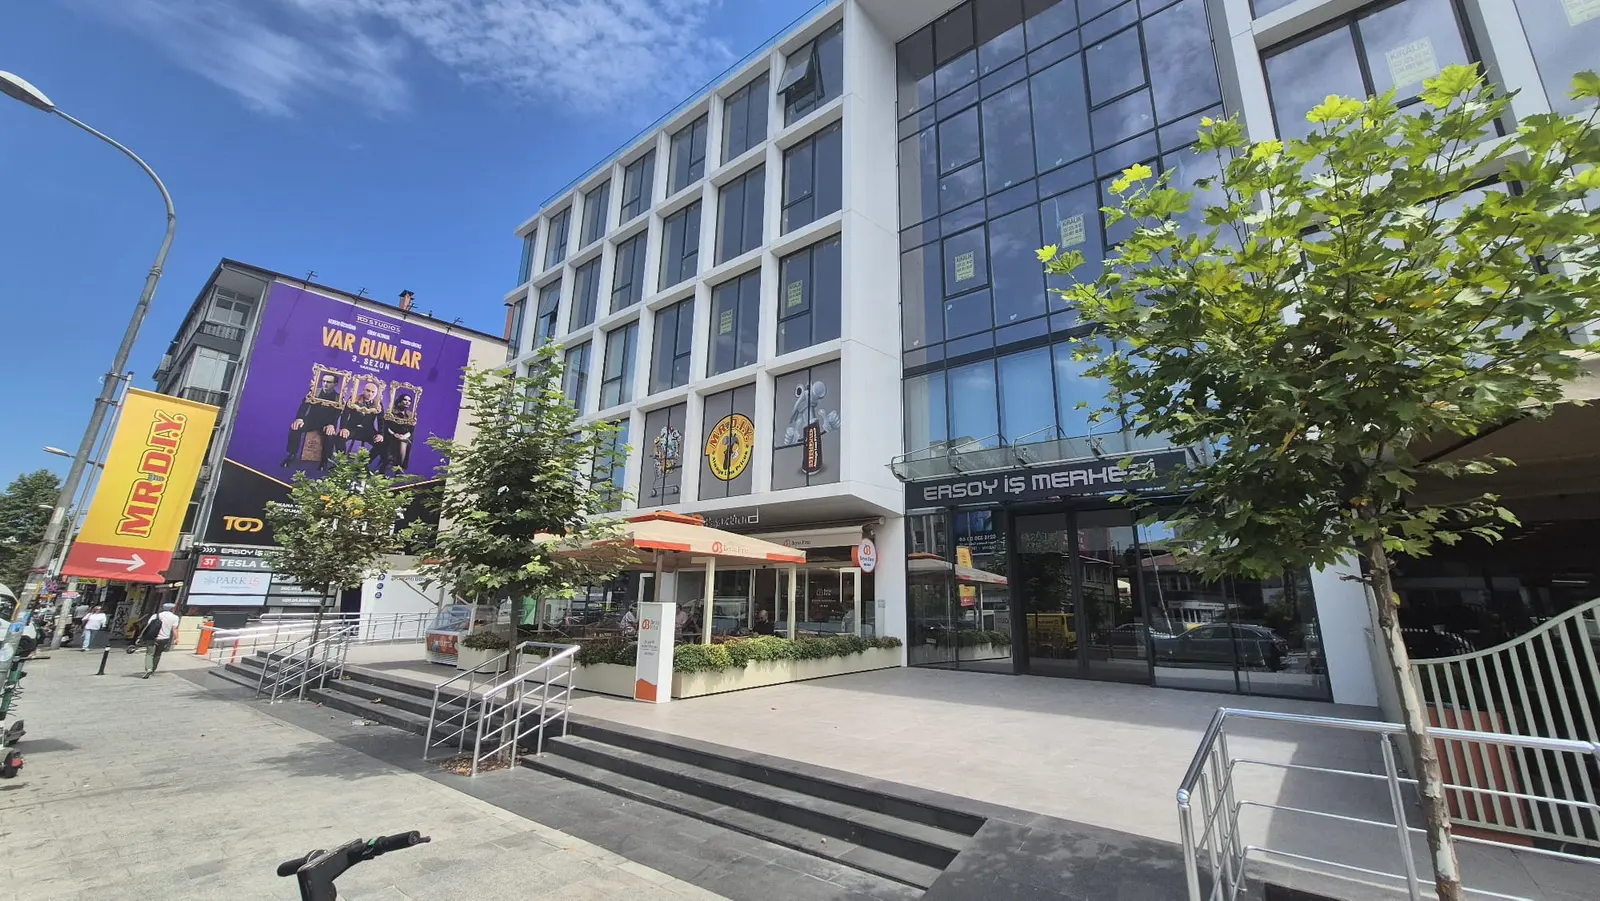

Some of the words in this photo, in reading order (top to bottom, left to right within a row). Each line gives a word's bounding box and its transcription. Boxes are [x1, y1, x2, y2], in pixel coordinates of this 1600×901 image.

[369, 319, 400, 333] STUDIOS
[322, 326, 356, 353] VAR
[359, 336, 422, 370] BUNLAR
[351, 355, 360, 363] 3.
[363, 358, 390, 370] SEZON
[923, 478, 999, 501] ERSOY
[223, 515, 264, 532] TOD
[220, 547, 254, 556] ERSOY
[203, 558, 216, 566] 3T
[220, 558, 257, 568] TESLA
[216, 576, 246, 585] PARK
